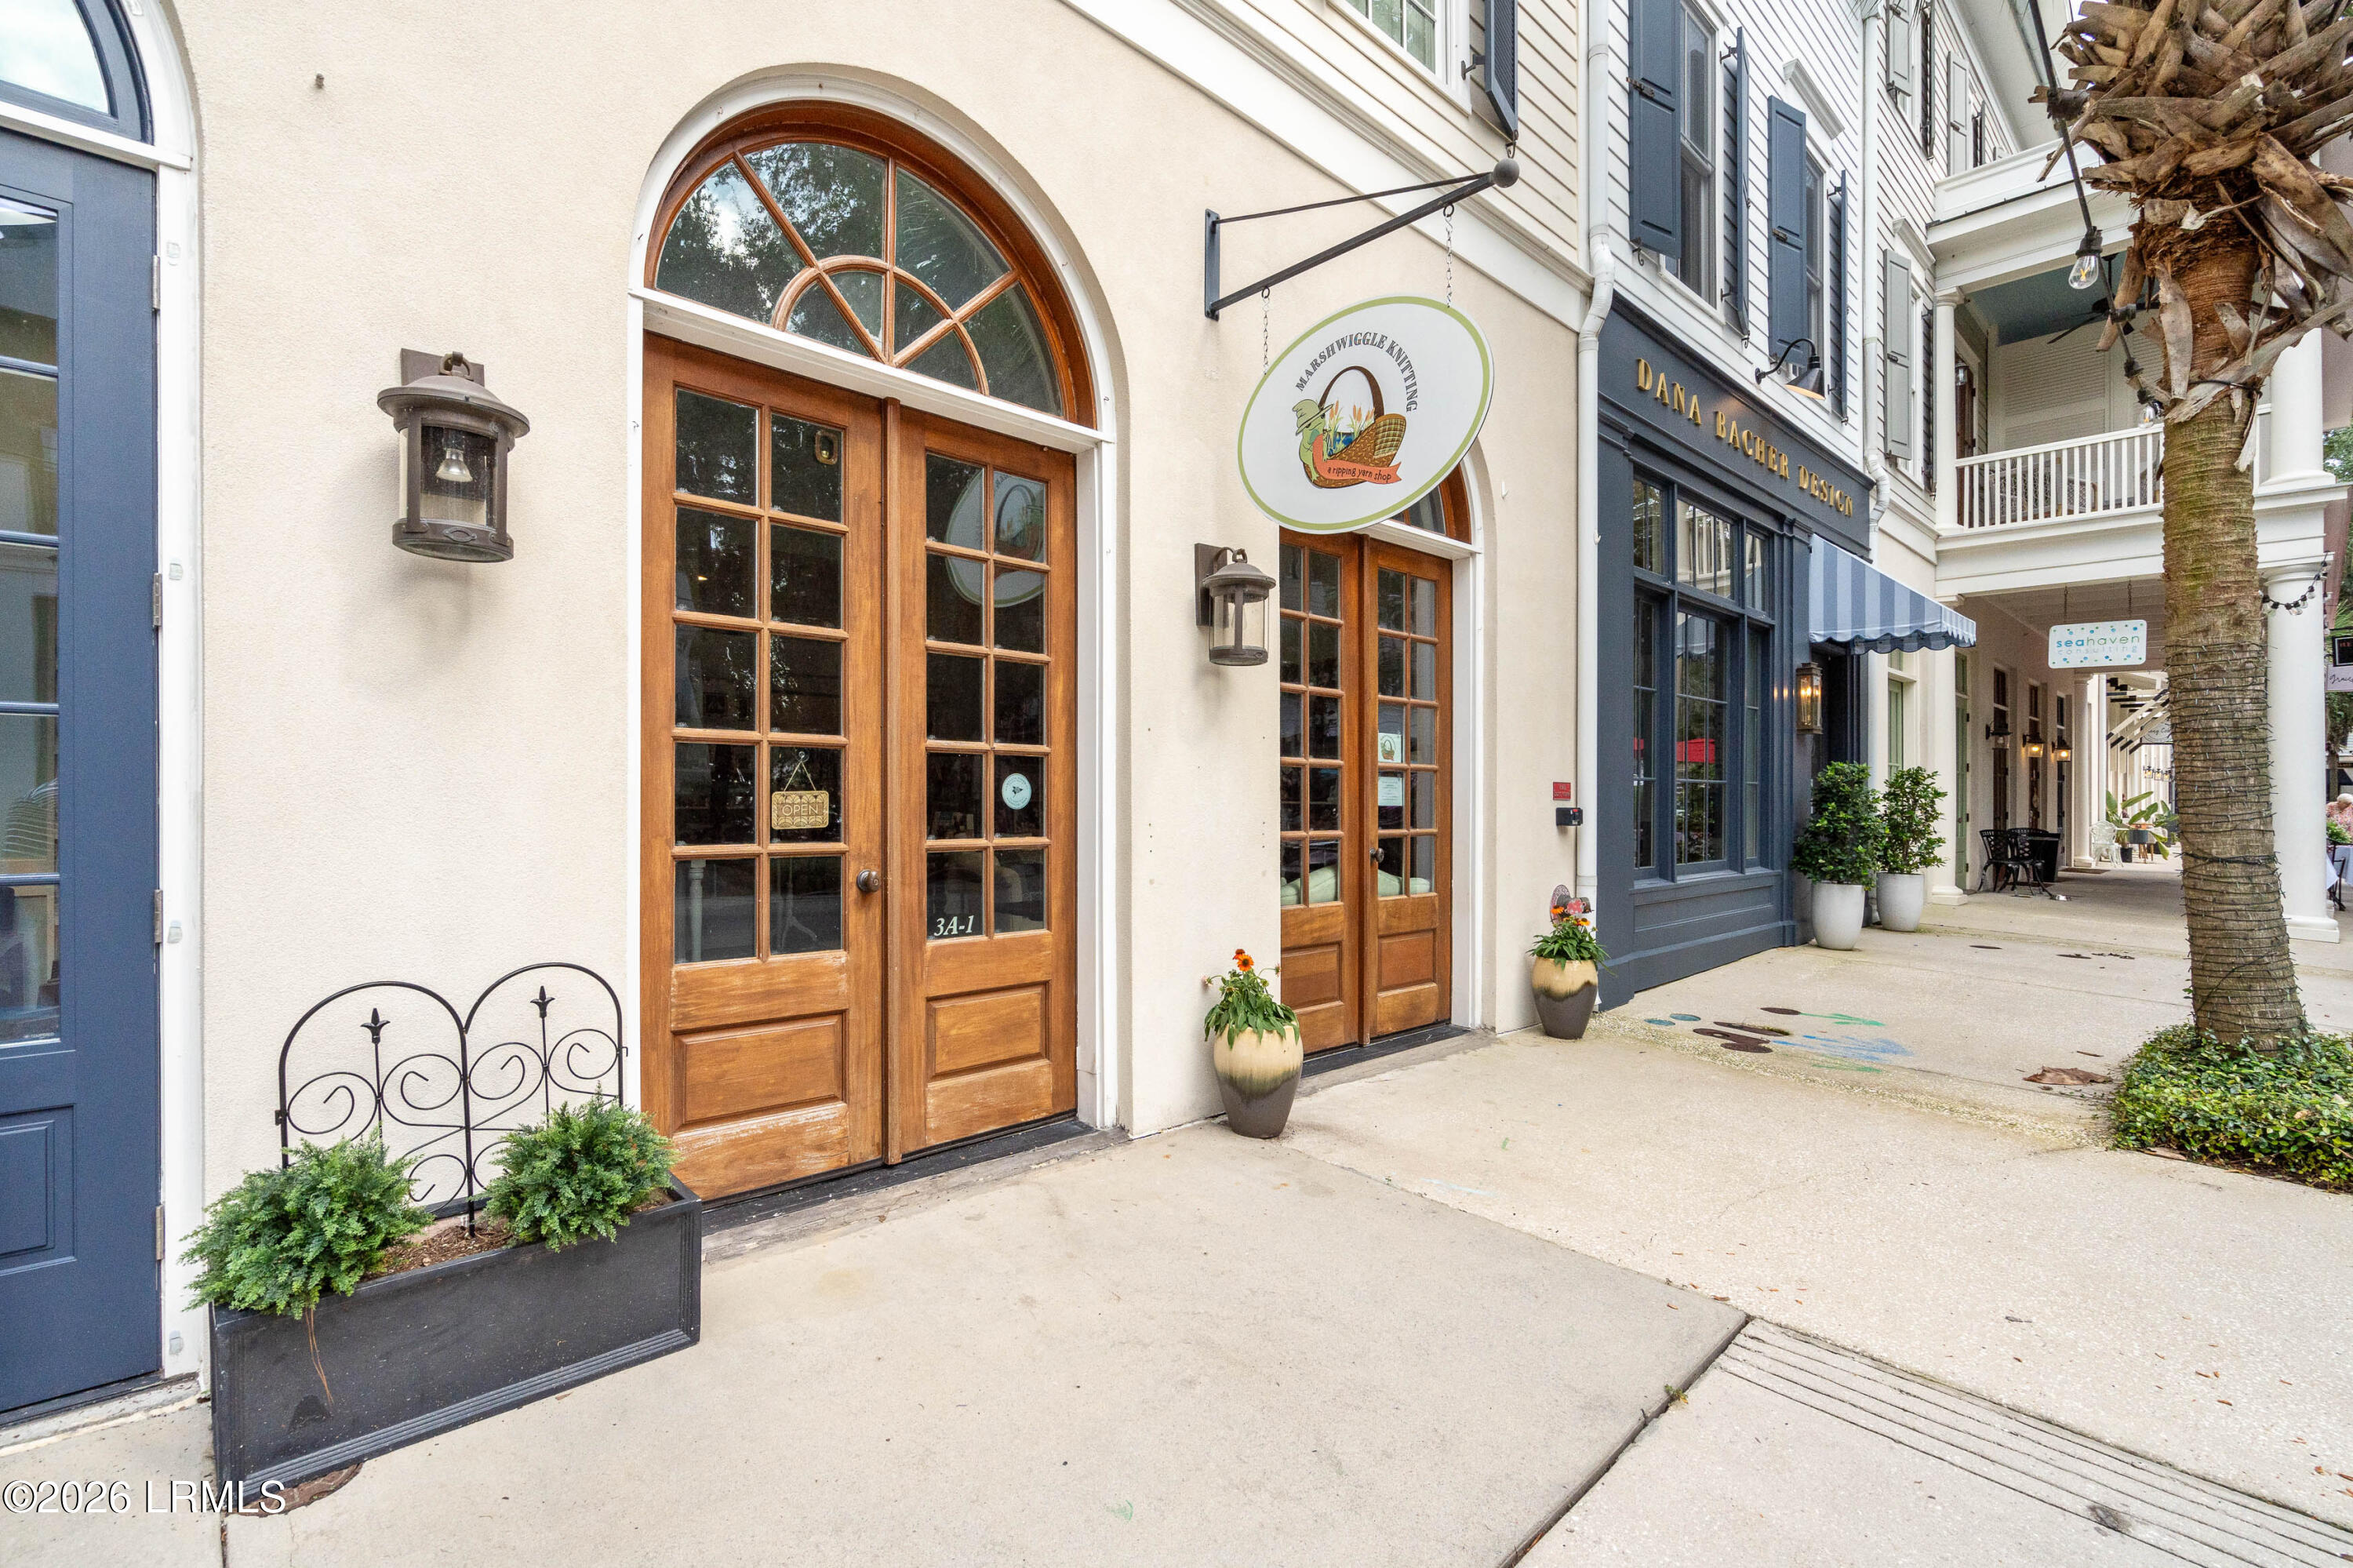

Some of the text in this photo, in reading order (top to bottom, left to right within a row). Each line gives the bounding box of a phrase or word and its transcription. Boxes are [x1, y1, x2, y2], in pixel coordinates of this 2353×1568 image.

[1296, 332, 1418, 412] MARSHWIGGLE KNITTING
[1637, 358, 1853, 517] DANA BACHER DESIGN
[1333, 467, 1356, 477] ripping
[1357, 468, 1372, 478] yarn
[1374, 469, 1391, 483] shop
[2057, 635, 2140, 648] seahaven
[2057, 646, 2137, 655] consulting
[782, 804, 818, 816] OPEN
[933, 915, 974, 937] 3A-1
